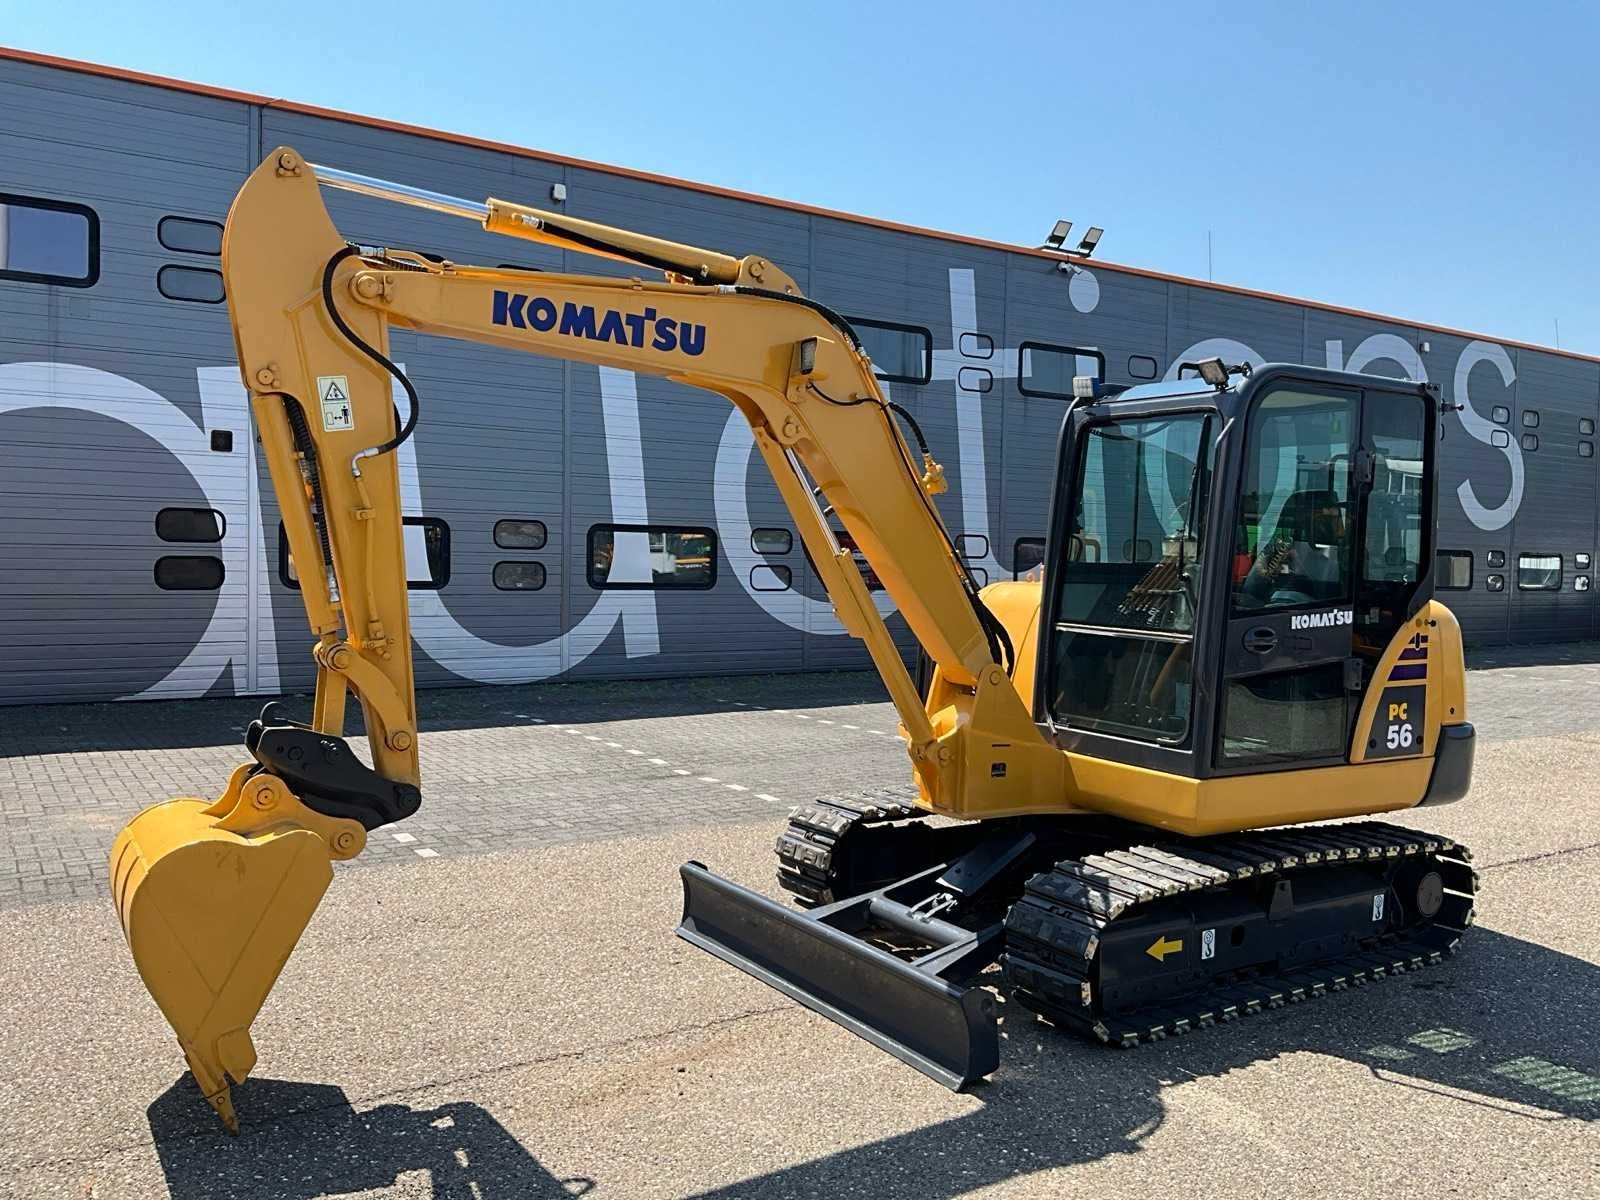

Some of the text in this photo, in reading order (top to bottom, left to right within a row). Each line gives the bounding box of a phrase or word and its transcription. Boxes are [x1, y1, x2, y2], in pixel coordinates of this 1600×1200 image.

[492, 290, 706, 356] KOMATSU
[1291, 609, 1353, 629] KOMATSU
[1388, 703, 1408, 721] PC
[1386, 724, 1413, 750] 56
